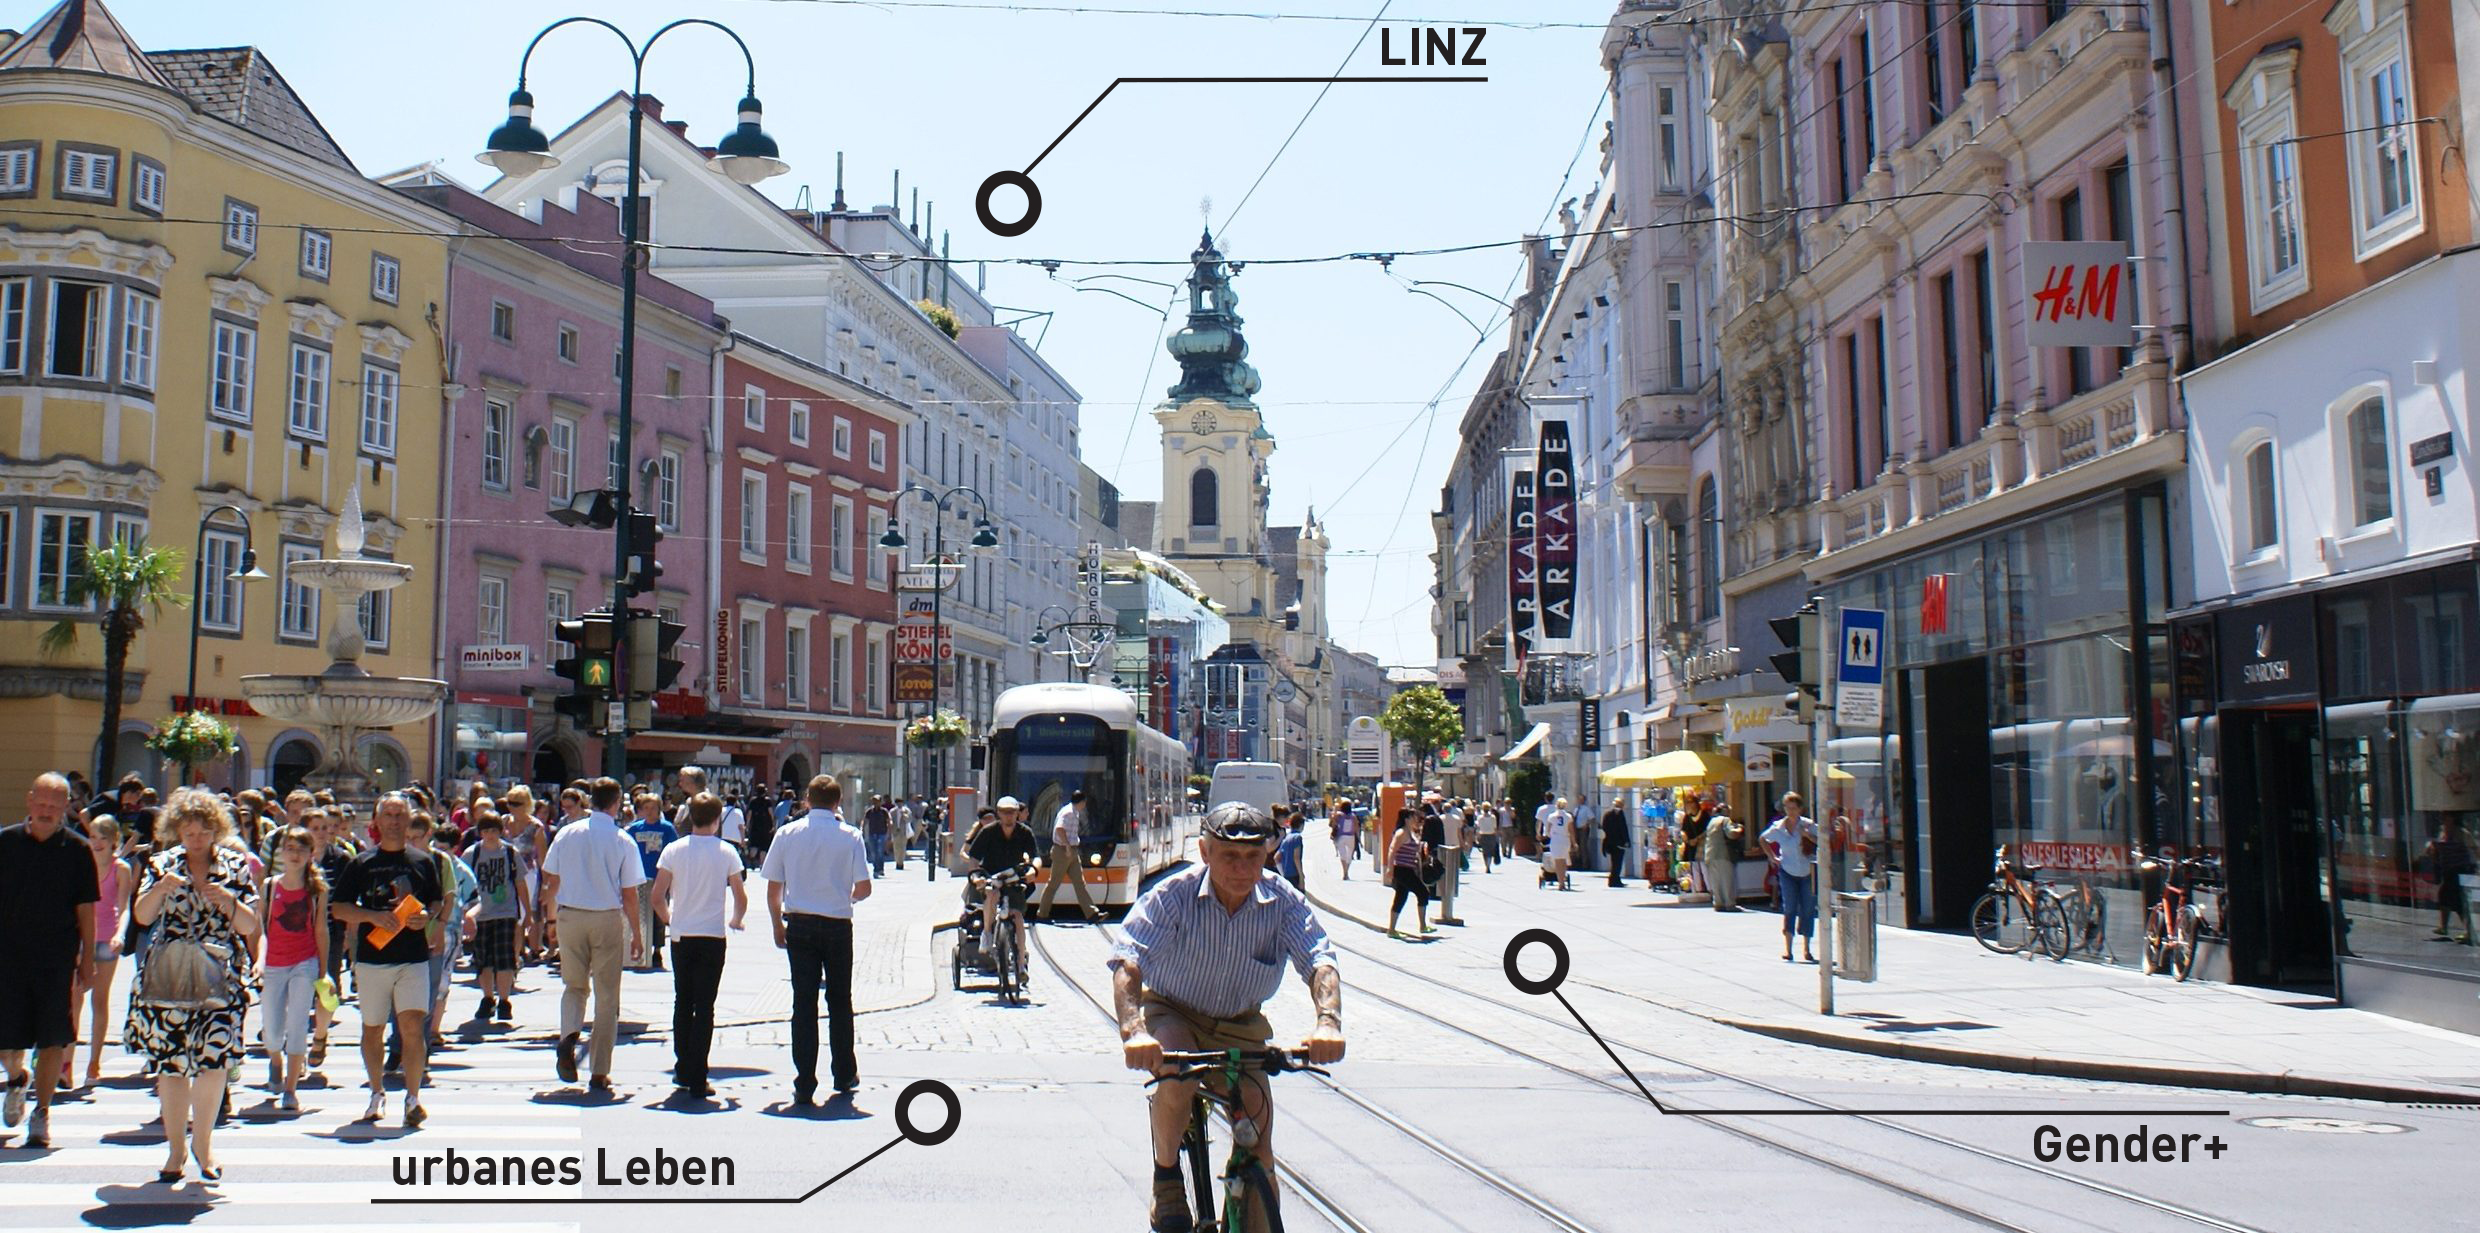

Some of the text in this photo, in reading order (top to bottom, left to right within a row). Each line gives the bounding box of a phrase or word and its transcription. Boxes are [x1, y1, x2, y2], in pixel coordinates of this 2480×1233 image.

[2033, 263, 2120, 323] H&M
[1544, 438, 1570, 620] ARKADE
[1516, 485, 1538, 643] ARKADE
[909, 597, 933, 611] dm
[897, 625, 952, 639] STIEFEL
[464, 648, 522, 661] minibox
[896, 639, 951, 659] KÖNG
[1584, 704, 1596, 746] MANGO
[1557, 816, 1564, 826] 3
